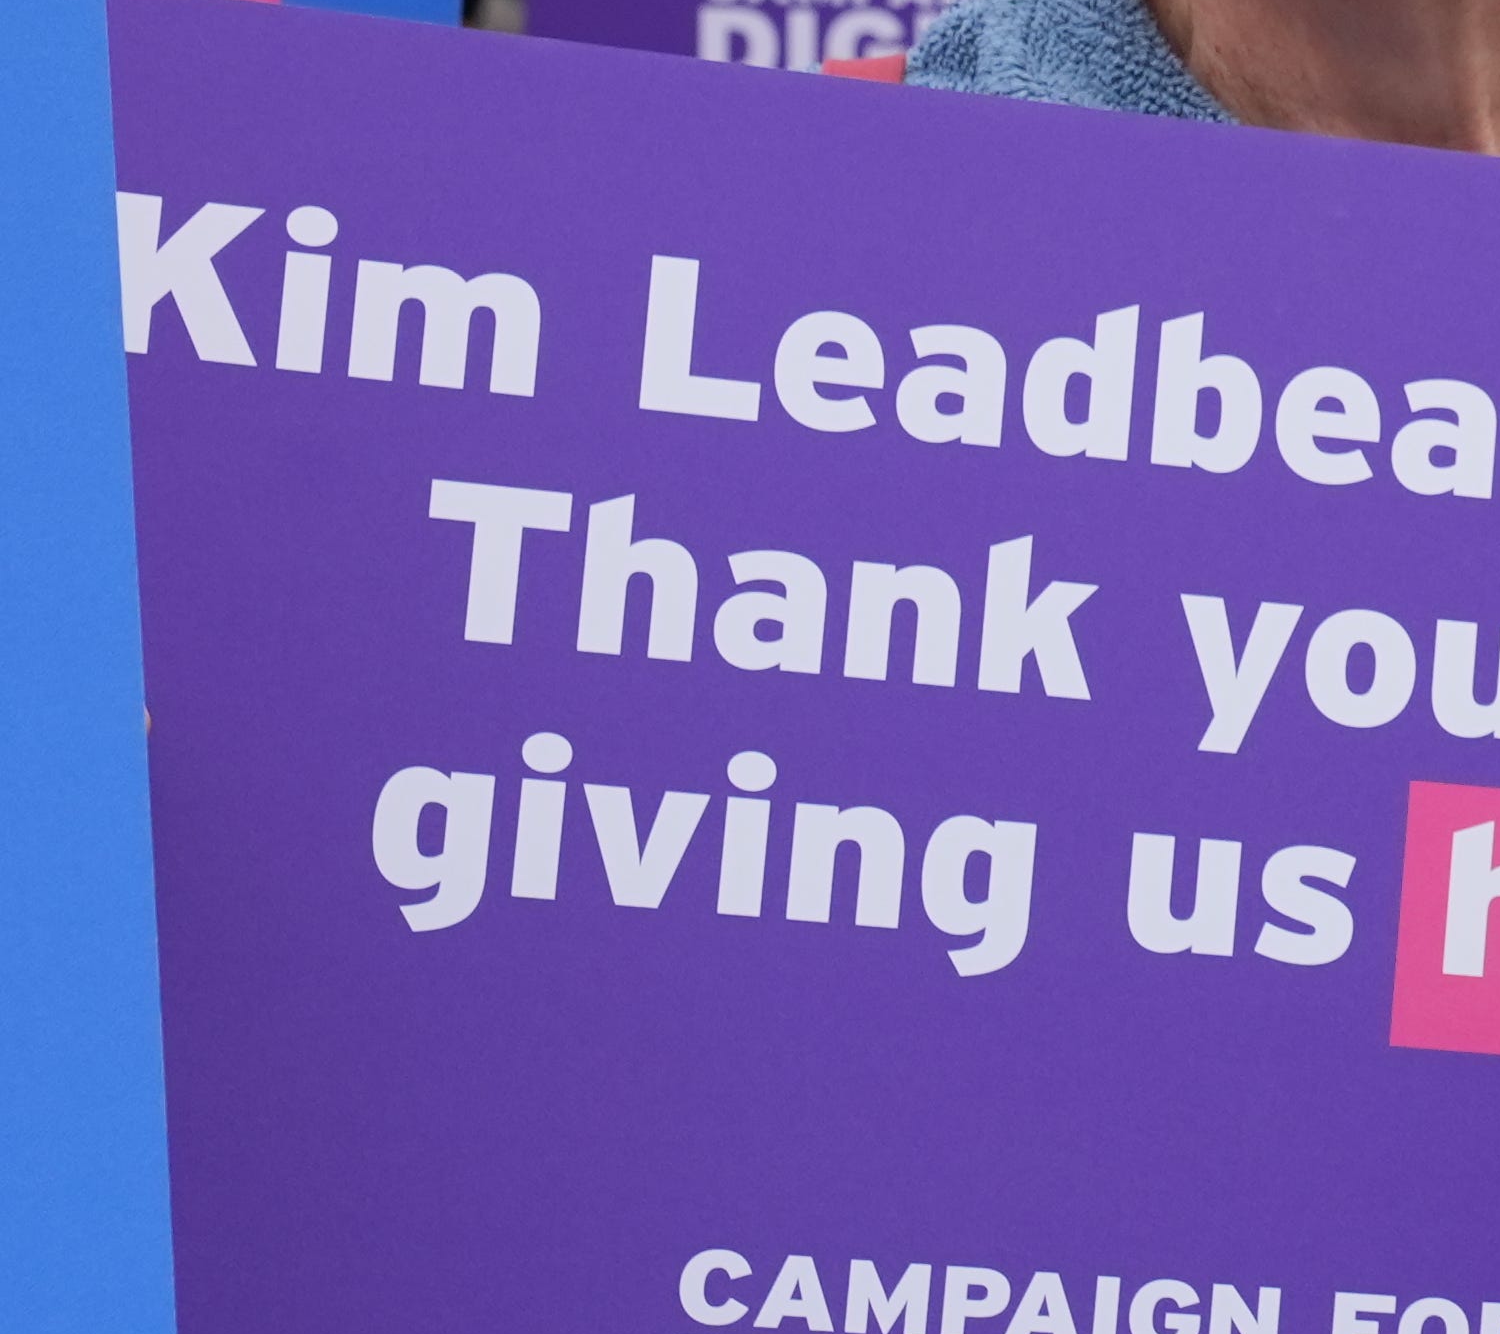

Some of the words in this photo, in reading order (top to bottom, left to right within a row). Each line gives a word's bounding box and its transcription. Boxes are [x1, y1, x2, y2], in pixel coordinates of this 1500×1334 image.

[116, 191, 541, 397] Kim
[429, 479, 1099, 700] Thank
[373, 732, 1037, 976] giving
[1128, 833, 1356, 965] us
